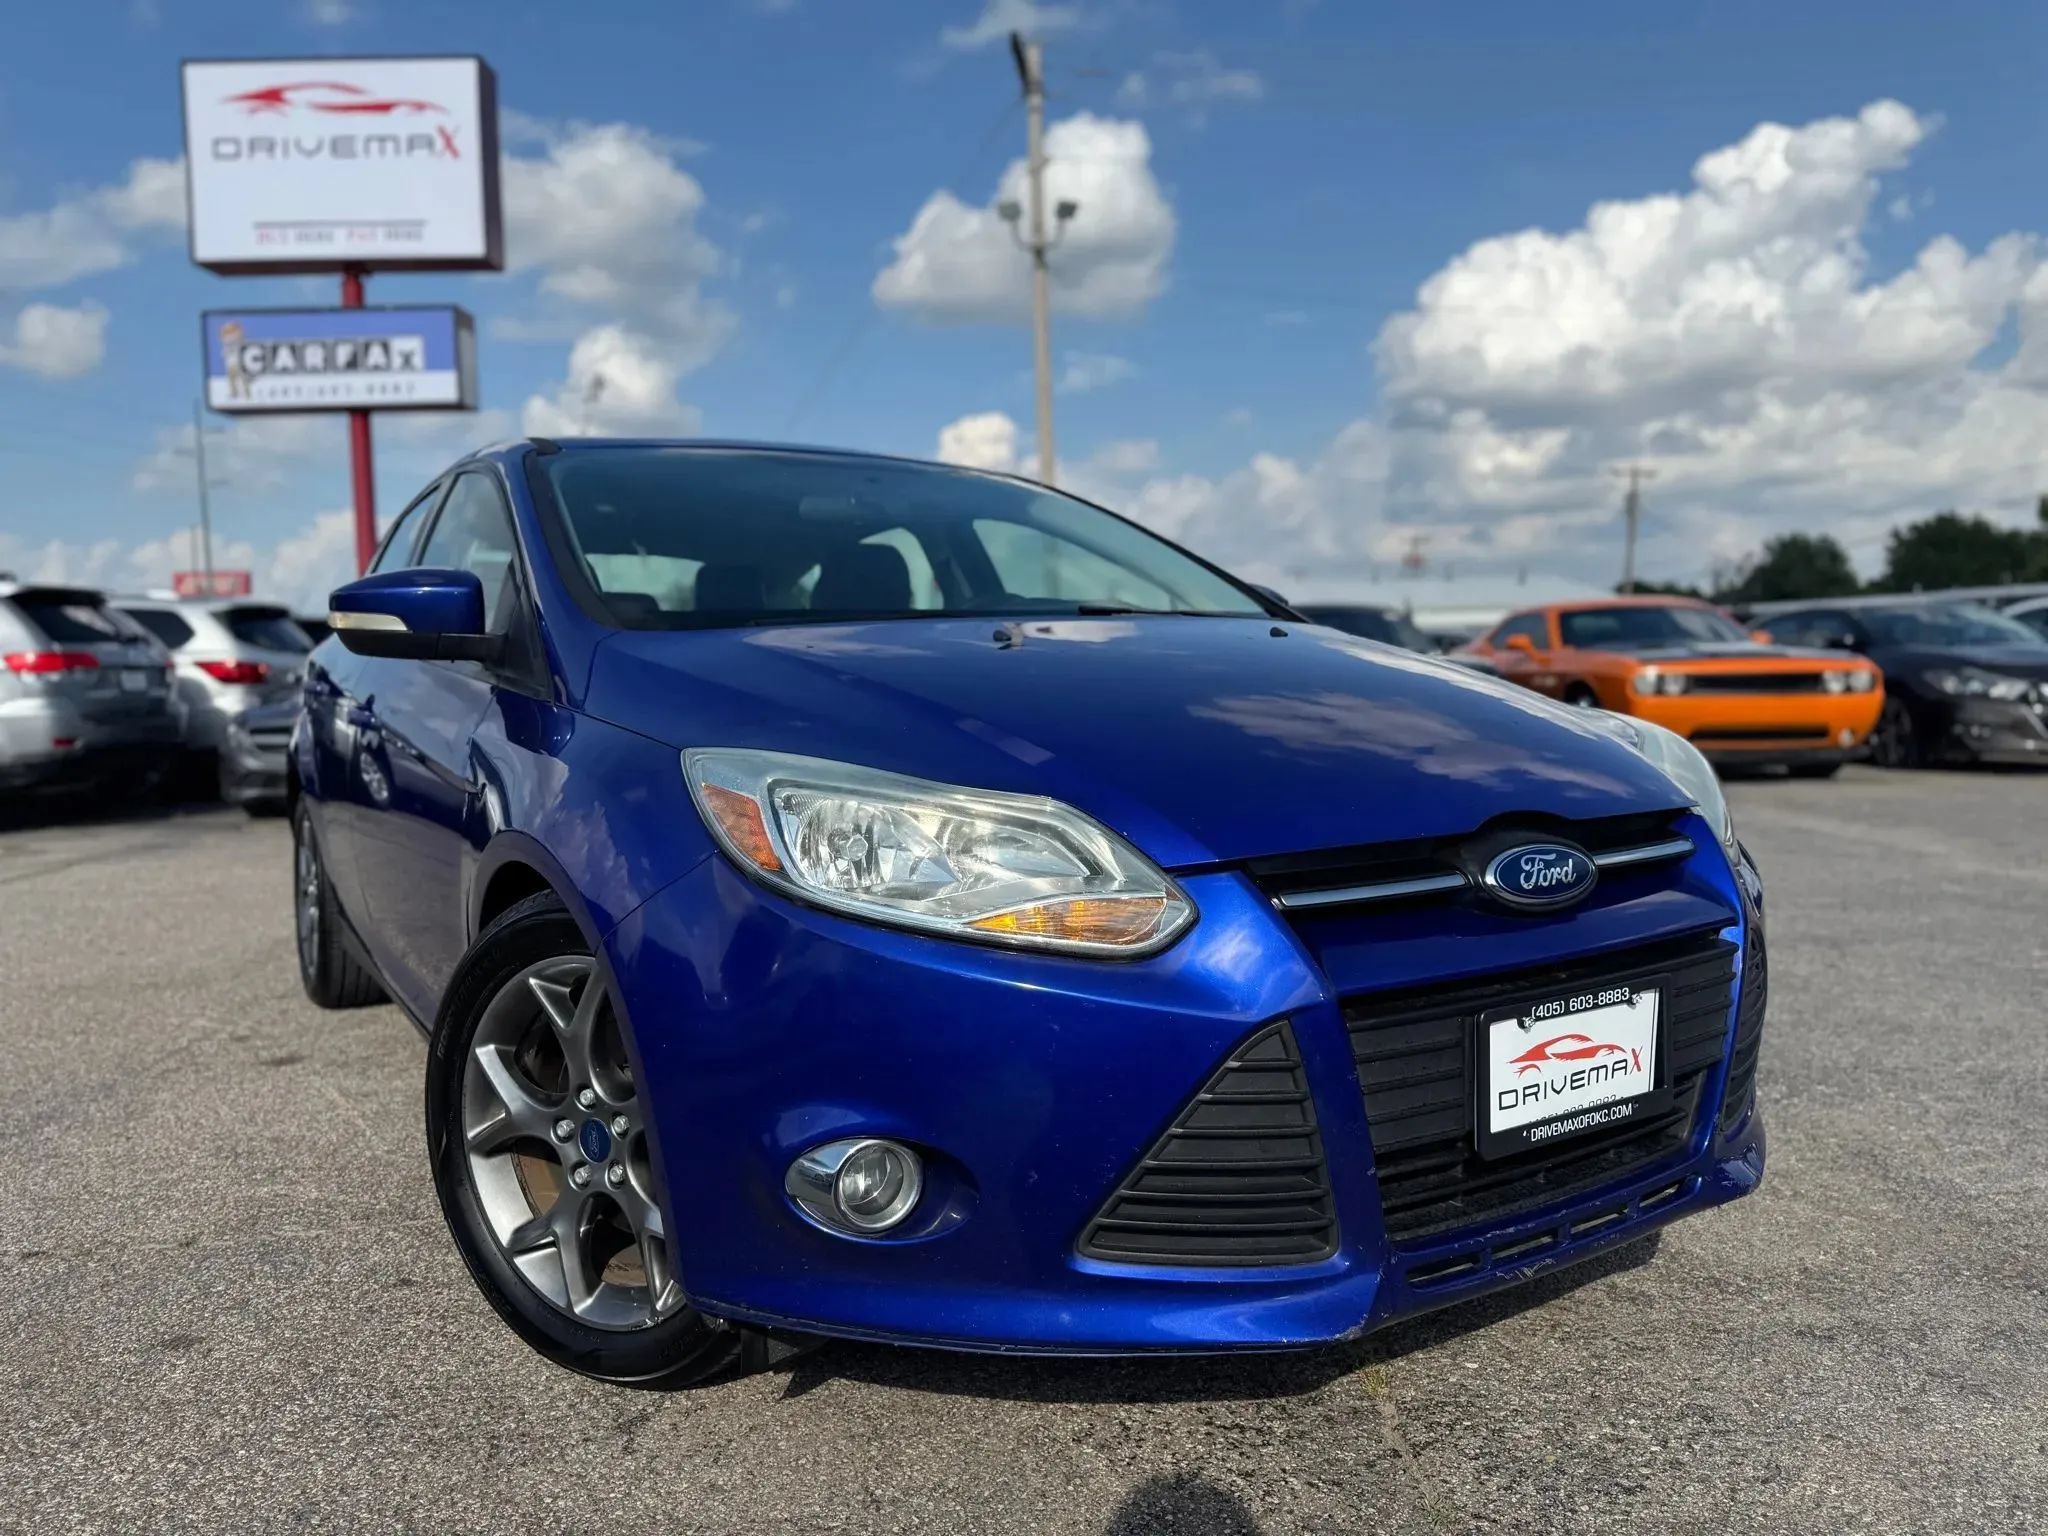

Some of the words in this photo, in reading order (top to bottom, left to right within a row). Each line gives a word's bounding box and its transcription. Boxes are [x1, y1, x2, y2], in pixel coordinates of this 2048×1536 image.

[211, 124, 461, 162] DRIVEMAX
[1520, 852, 1577, 890] Ford
[1531, 1001, 1565, 1020] (405)
[1569, 987, 1630, 1011] 603-8883
[1498, 1045, 1644, 1111] DRIVEMAX
[1530, 1103, 1632, 1142] DRIVEMAXOFOKC.COM
